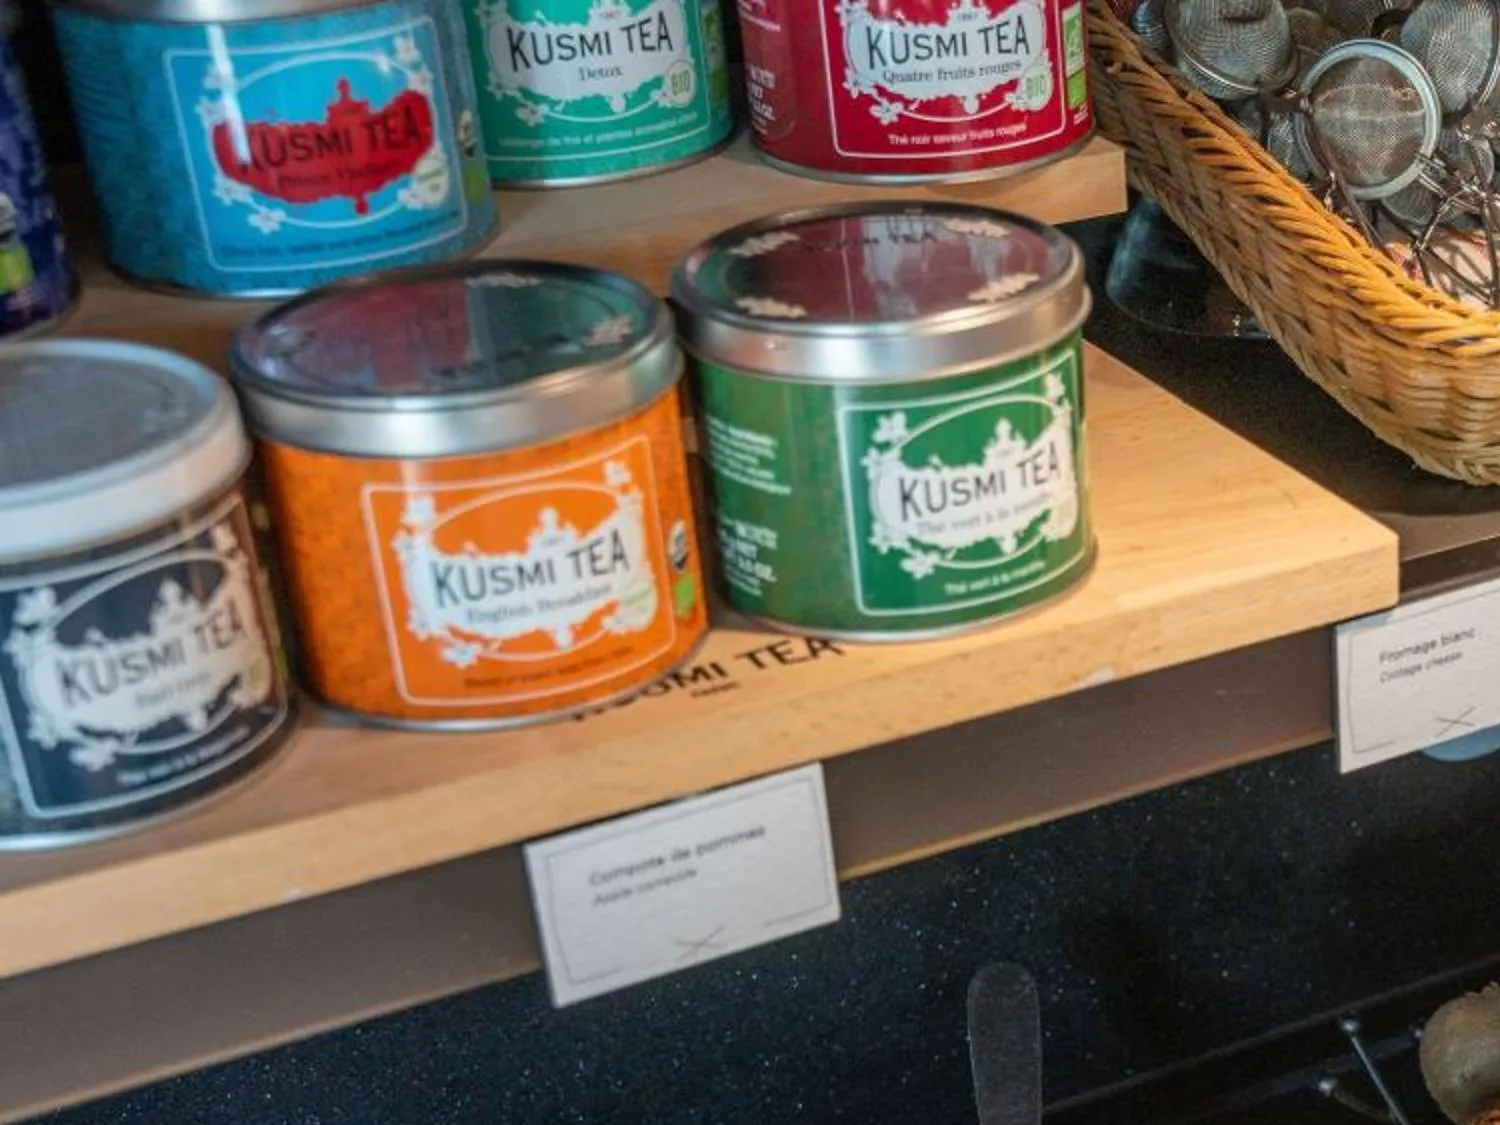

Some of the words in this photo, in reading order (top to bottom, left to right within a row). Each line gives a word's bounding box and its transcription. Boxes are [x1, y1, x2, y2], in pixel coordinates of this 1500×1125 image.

[507, 27, 612, 72] KUSMI
[620, 11, 673, 53] TEA
[866, 26, 968, 70] KUSMI
[979, 15, 1031, 55] TEA
[883, 69, 933, 84] Quatre
[937, 66, 975, 81] fruits
[979, 61, 1022, 77] rouges
[364, 105, 423, 151] TEA
[899, 471, 1007, 522] KUSMI
[1017, 441, 1062, 488] TEA
[430, 558, 556, 609] KUSMI
[566, 529, 631, 579] TEA
[55, 636, 187, 707] KUSMI
[194, 600, 242, 655] TEA
[734, 636, 847, 671] TEA
[1379, 640, 1437, 662] Fromage
[1441, 627, 1477, 646] blanc
[589, 857, 665, 886] Compote
[670, 847, 691, 863] de
[696, 826, 765, 855] pommes
